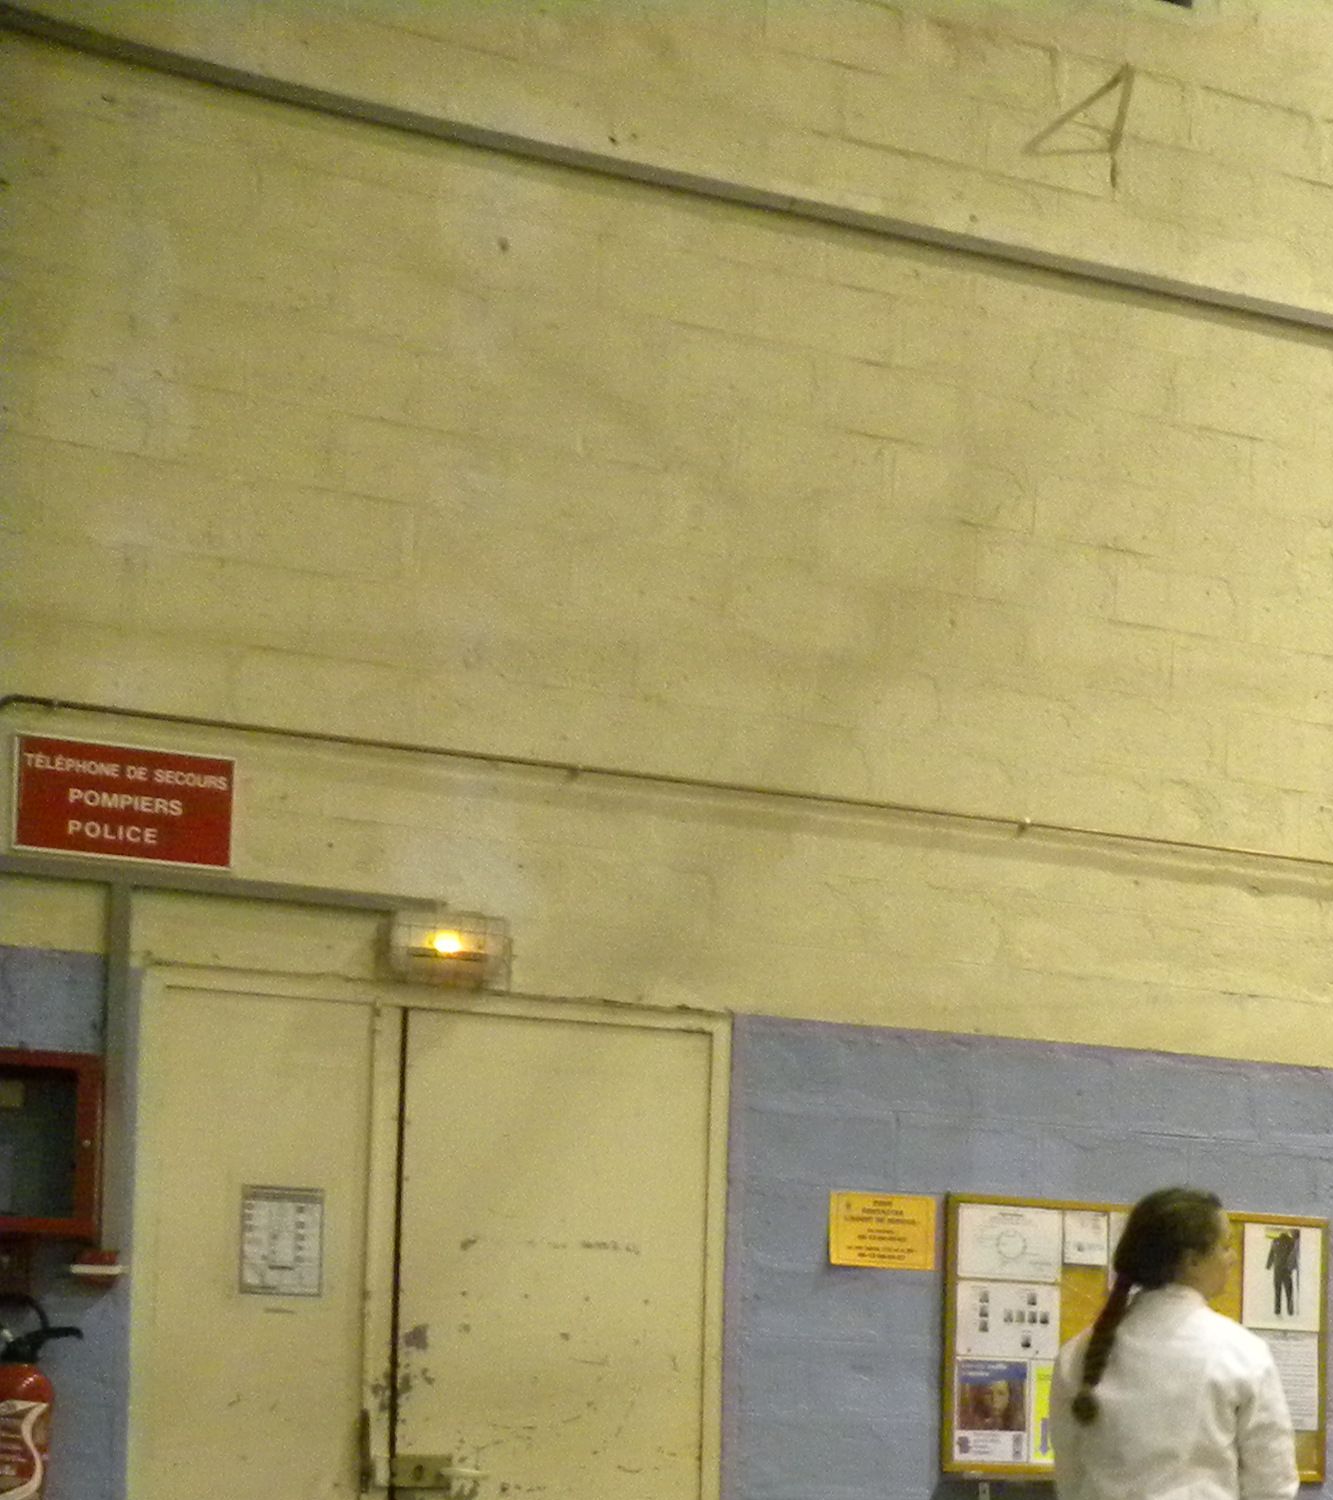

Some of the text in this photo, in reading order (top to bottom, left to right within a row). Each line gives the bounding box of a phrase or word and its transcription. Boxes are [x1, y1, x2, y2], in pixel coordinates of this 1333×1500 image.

[25, 751, 228, 791] TÉLÉPHONE DE SECOURS
[68, 788, 183, 816] POMPIERS
[67, 820, 158, 844] POLICE
